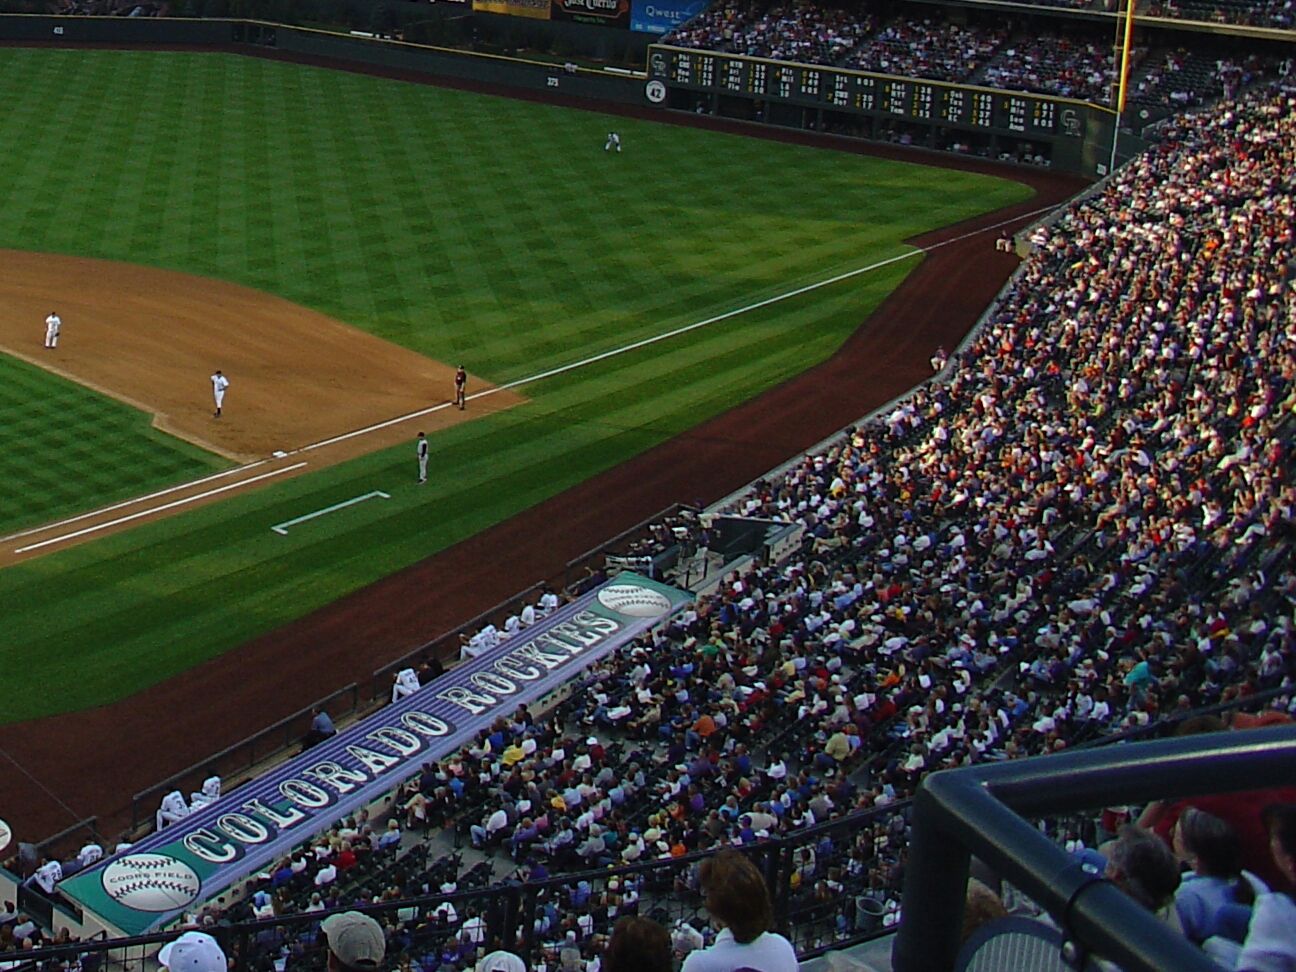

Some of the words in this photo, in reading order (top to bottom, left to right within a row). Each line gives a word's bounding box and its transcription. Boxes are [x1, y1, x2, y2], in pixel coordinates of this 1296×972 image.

[645, 5, 681, 20] Qwest
[678, 53, 690, 61] Phi
[677, 75, 689, 83] Cin
[980, 94, 992, 102] 40
[890, 105, 904, 114] Tam
[182, 711, 450, 864] COLORADO
[436, 609, 620, 715] ROCKIES
[109, 872, 151, 883] COORS
[155, 871, 193, 880] FIELD
